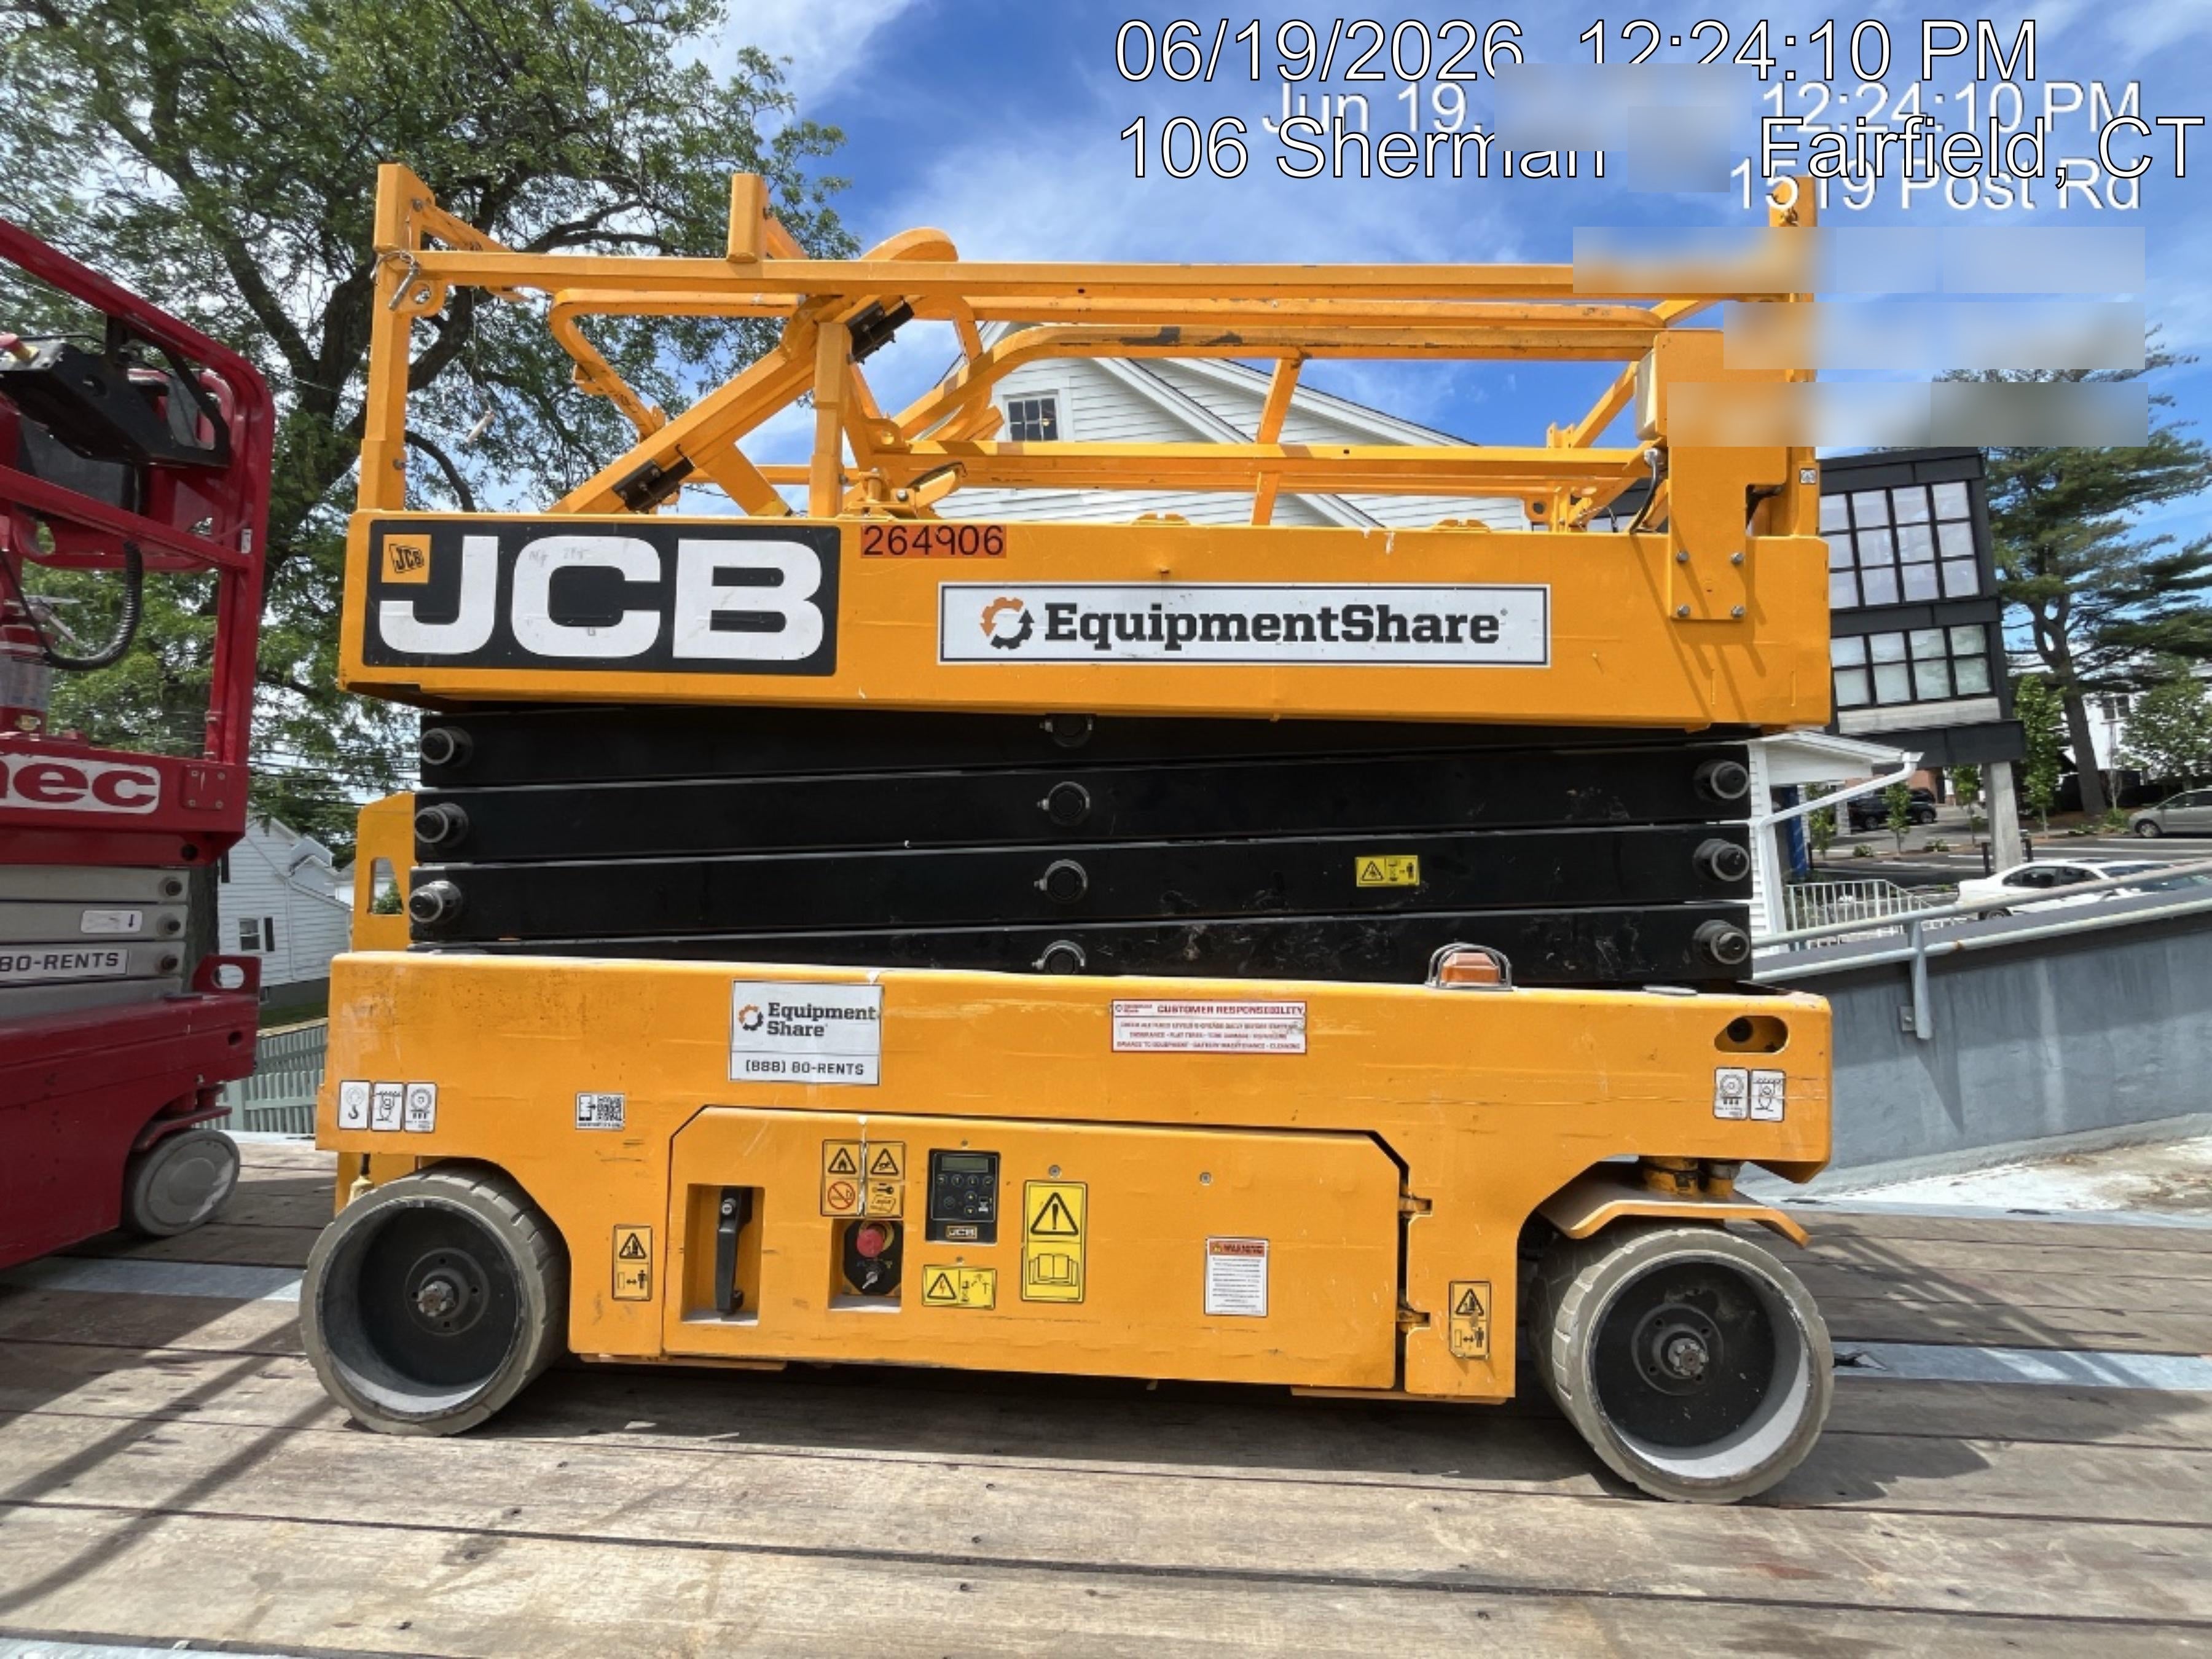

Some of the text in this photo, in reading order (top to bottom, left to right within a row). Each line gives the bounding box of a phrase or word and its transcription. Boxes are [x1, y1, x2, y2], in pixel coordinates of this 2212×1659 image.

[863, 525, 1004, 555] 264906
[393, 545, 423, 571] JCB
[378, 535, 825, 661] JCB
[1045, 603, 1500, 650] EquipmentShare
[767, 1002, 877, 1021] Equipment
[1216, 1006, 1304, 1014] RESPONSIBILITY
[767, 1021, 825, 1037] Share
